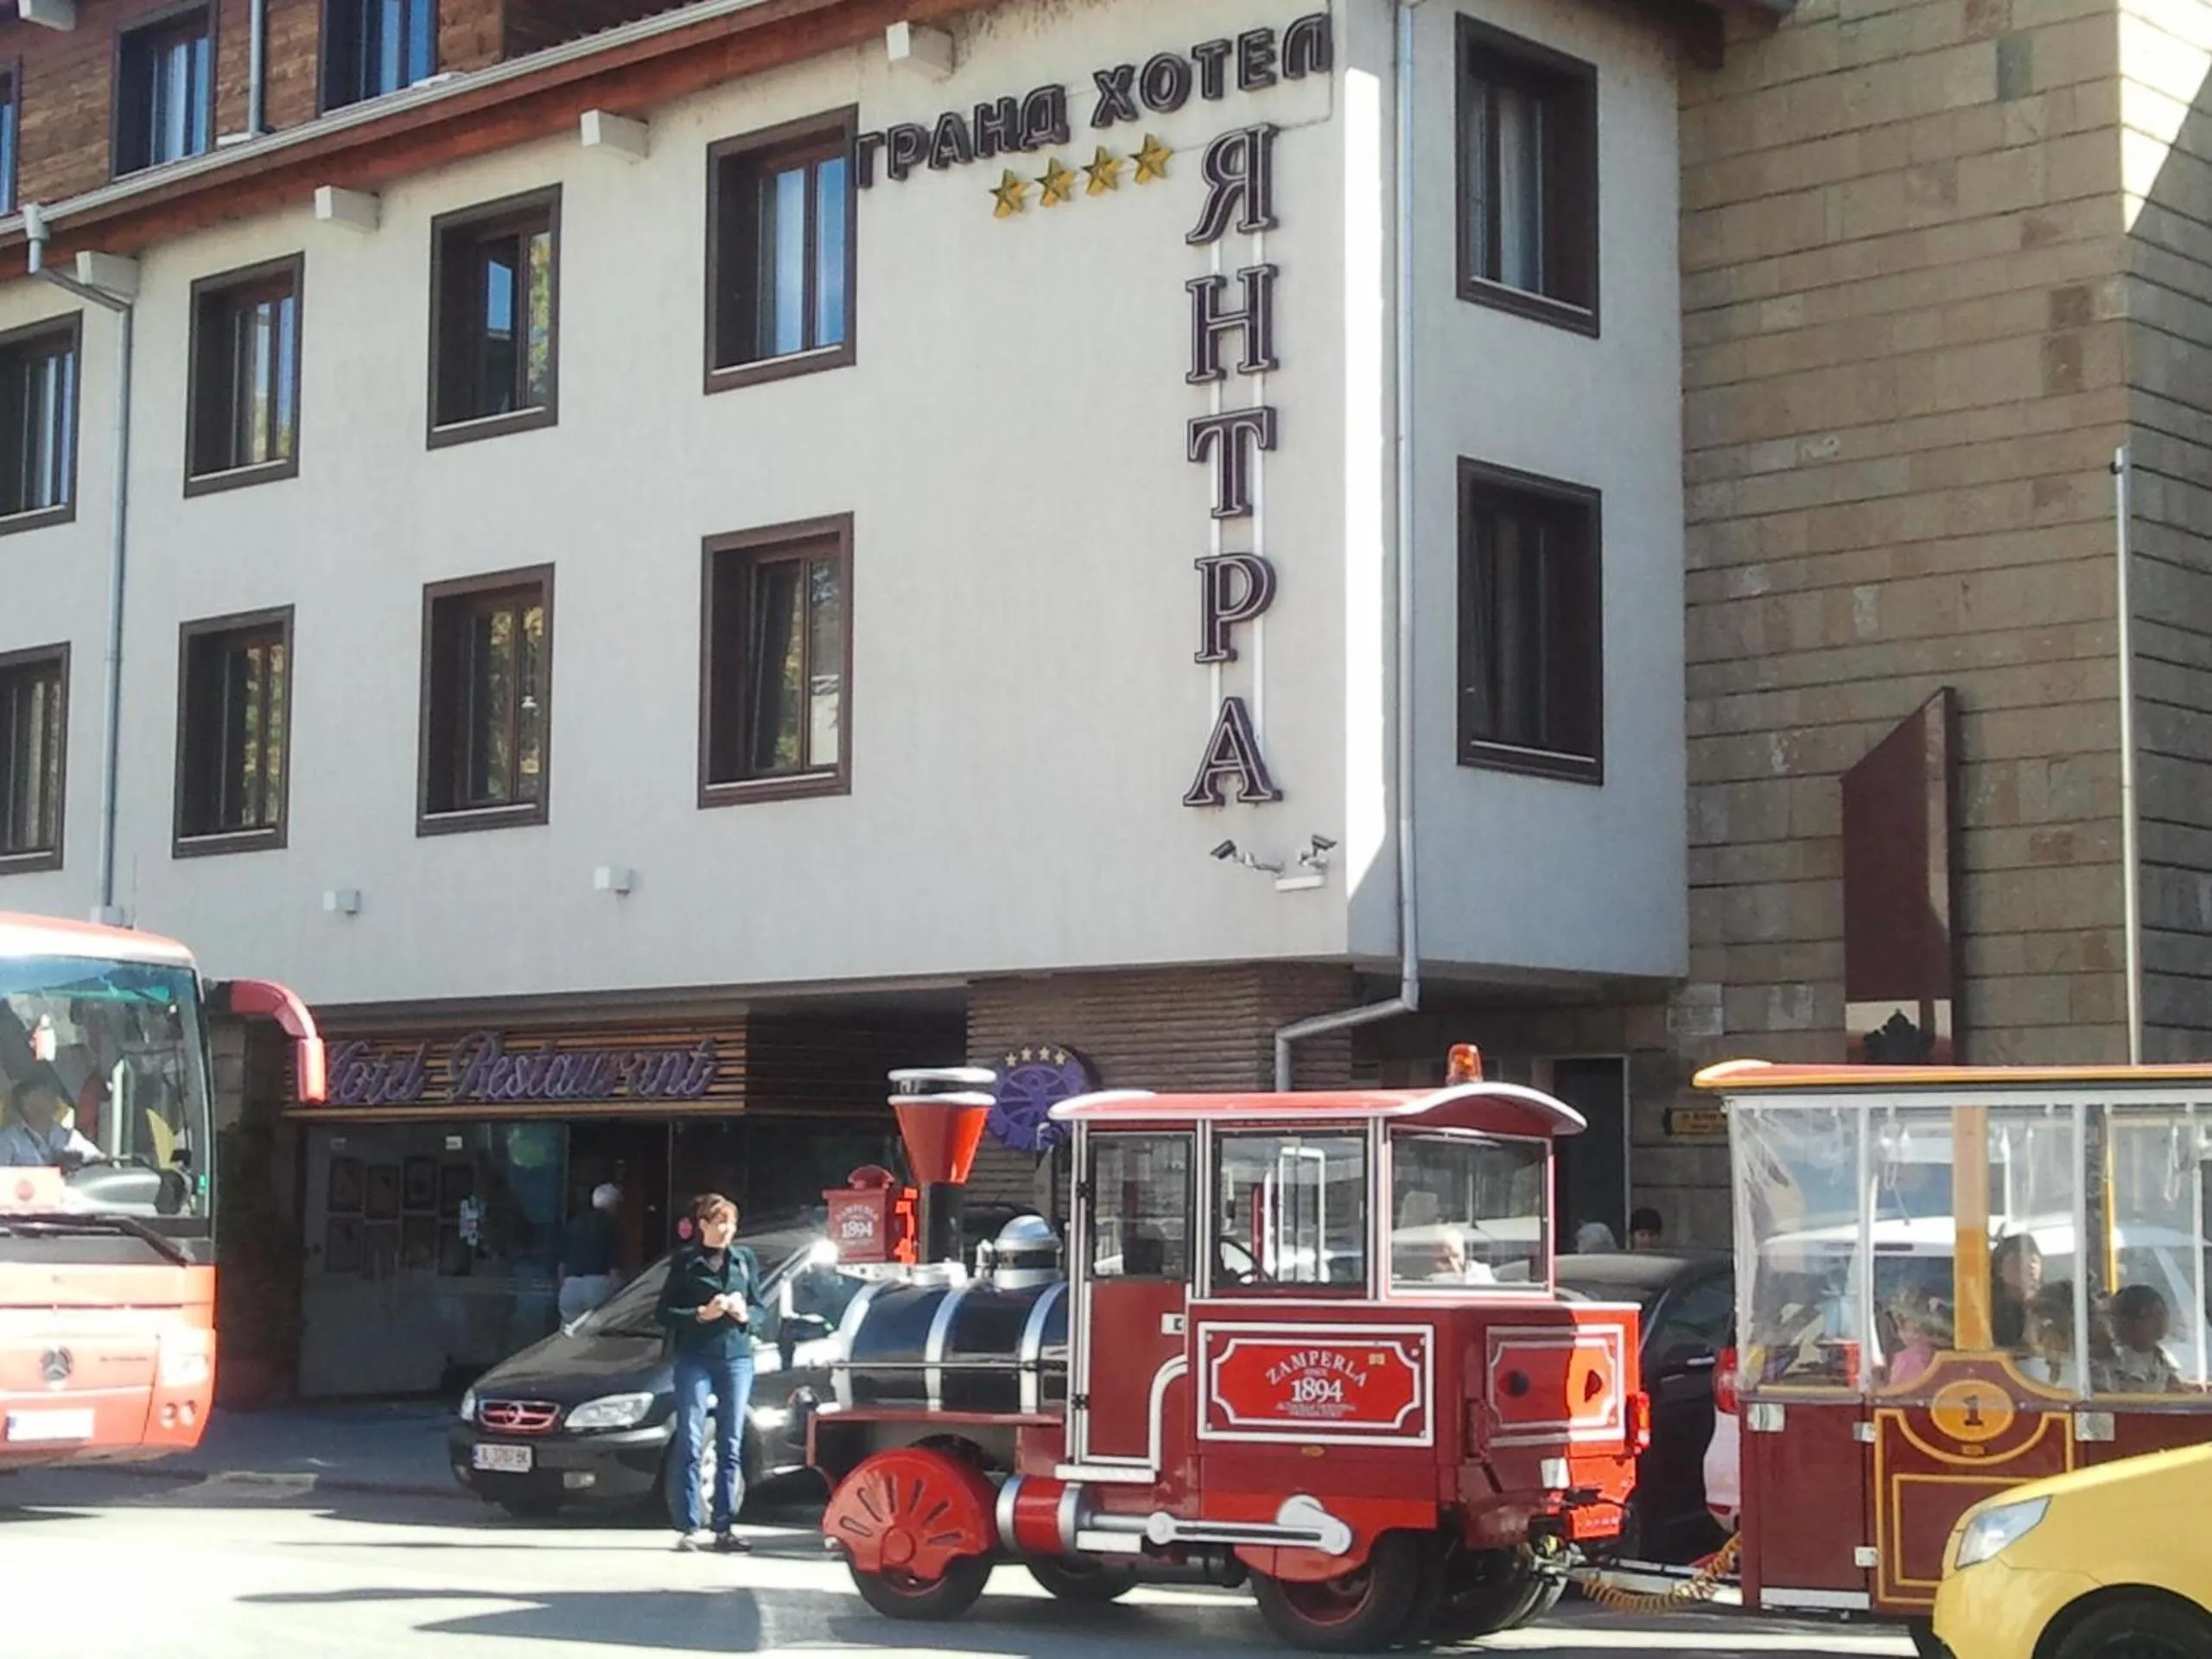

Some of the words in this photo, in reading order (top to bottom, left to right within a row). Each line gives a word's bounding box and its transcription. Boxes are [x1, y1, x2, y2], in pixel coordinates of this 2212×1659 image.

[852, 84, 1070, 189] ГРАНД
[1091, 12, 1332, 128] ХОТЕЛ
[1183, 123, 1282, 807] ЯНТРА
[1265, 1350, 1369, 1388] ZAMPERLA
[1290, 1376, 1344, 1403] 1894
[1962, 1394, 1985, 1427] 1
